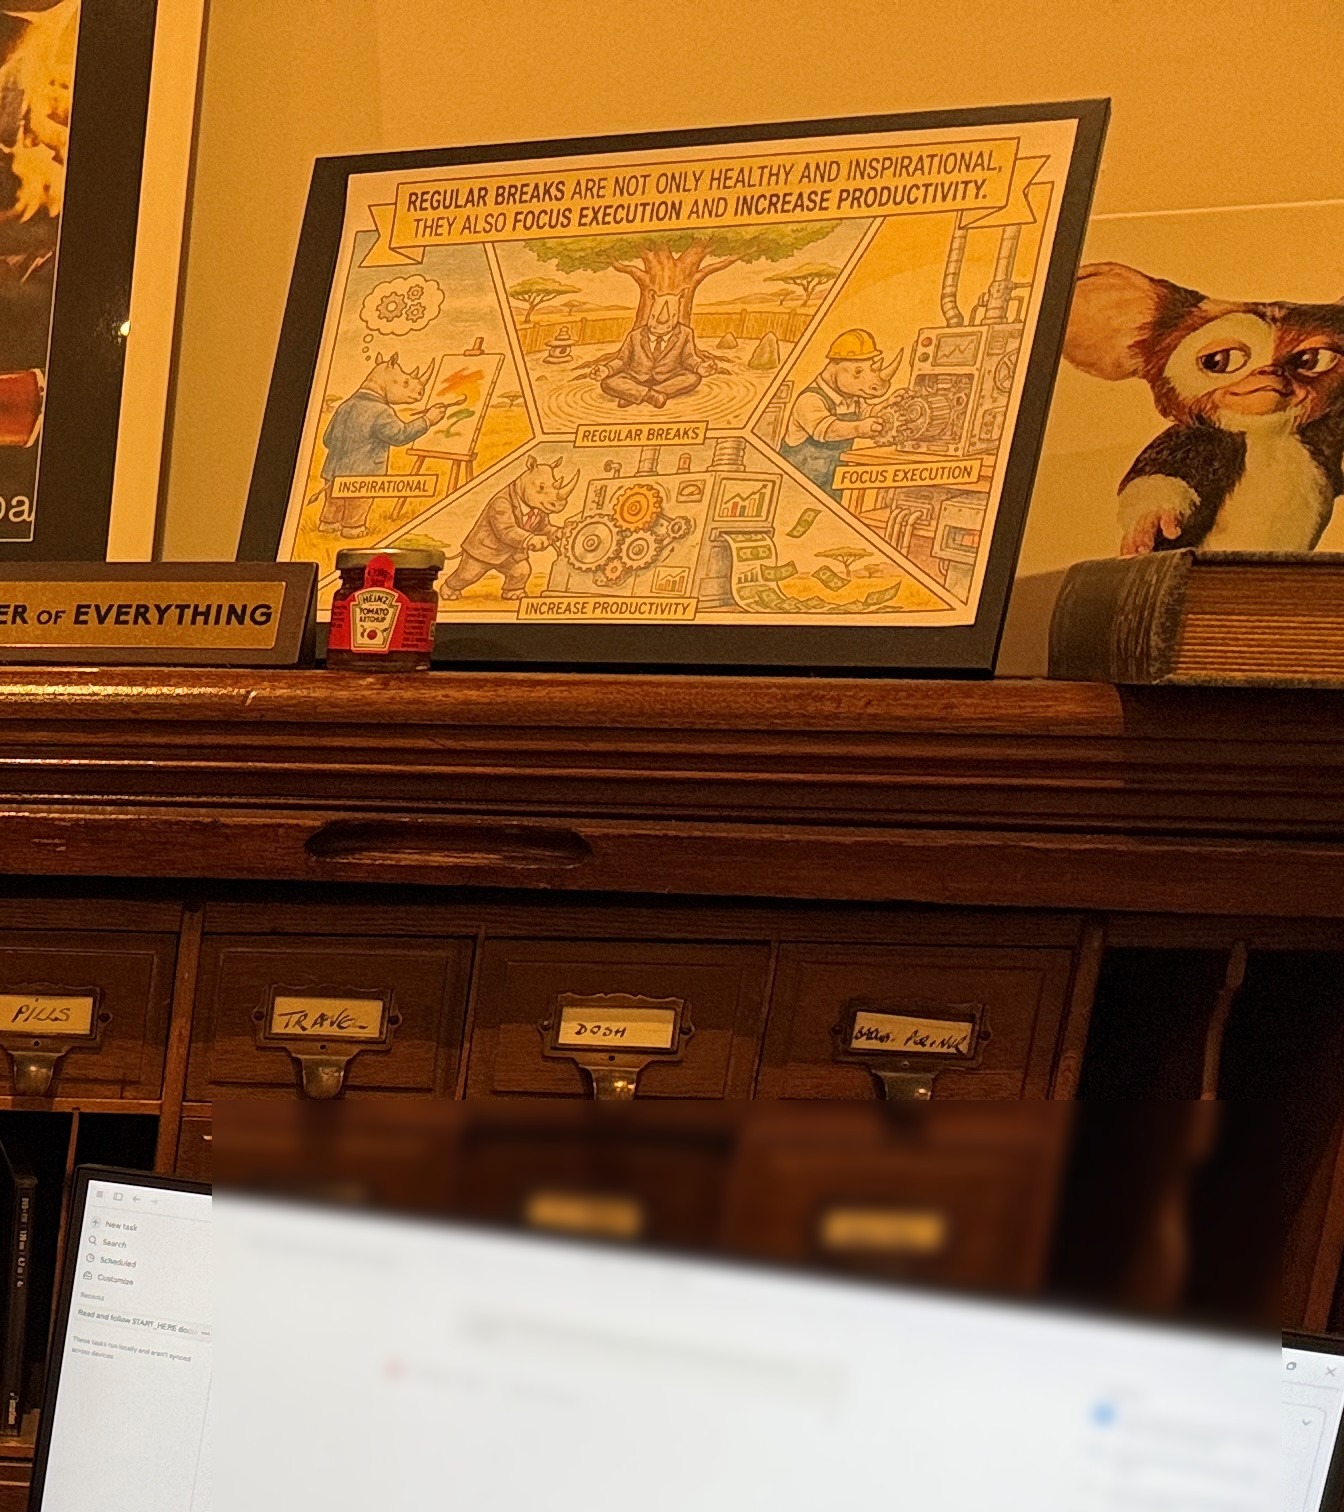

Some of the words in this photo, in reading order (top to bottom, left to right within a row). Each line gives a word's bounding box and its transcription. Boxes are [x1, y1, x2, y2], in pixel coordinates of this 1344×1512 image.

[407, 187, 488, 212] REGULAR
[494, 181, 565, 206] BREAKS
[571, 177, 608, 201] ARE
[612, 174, 651, 198] NOT
[656, 170, 704, 194] ONLY
[710, 164, 794, 191] HEALTHY
[799, 160, 840, 184] AND
[847, 150, 1002, 181] INSPIRATIONAL,
[414, 216, 457, 238] THEY
[460, 213, 507, 236] ALSO
[512, 208, 572, 232] FOCUS
[577, 200, 683, 228] EXECUTION
[687, 197, 727, 219] AND
[734, 189, 832, 217] INCREASE
[837, 179, 987, 211] PRODUCTIVITY.
[581, 428, 644, 444] REGULAR
[647, 426, 700, 441] BREAKS
[841, 469, 888, 484] FOCUS
[892, 465, 973, 483] EXECUTION
[338, 480, 429, 494] INSPIRATIONAL
[363, 593, 389, 605] HEINZ
[73, 604, 273, 626] EVERYTHING
[359, 607, 389, 617] TOMATO
[524, 601, 588, 615] INCREASE
[591, 601, 690, 616] PRODUCTIVITY
[12, 1003, 71, 1023] PILLS
[102, 1238, 127, 1249] Search
[99, 1256, 137, 1269] Scheduled
